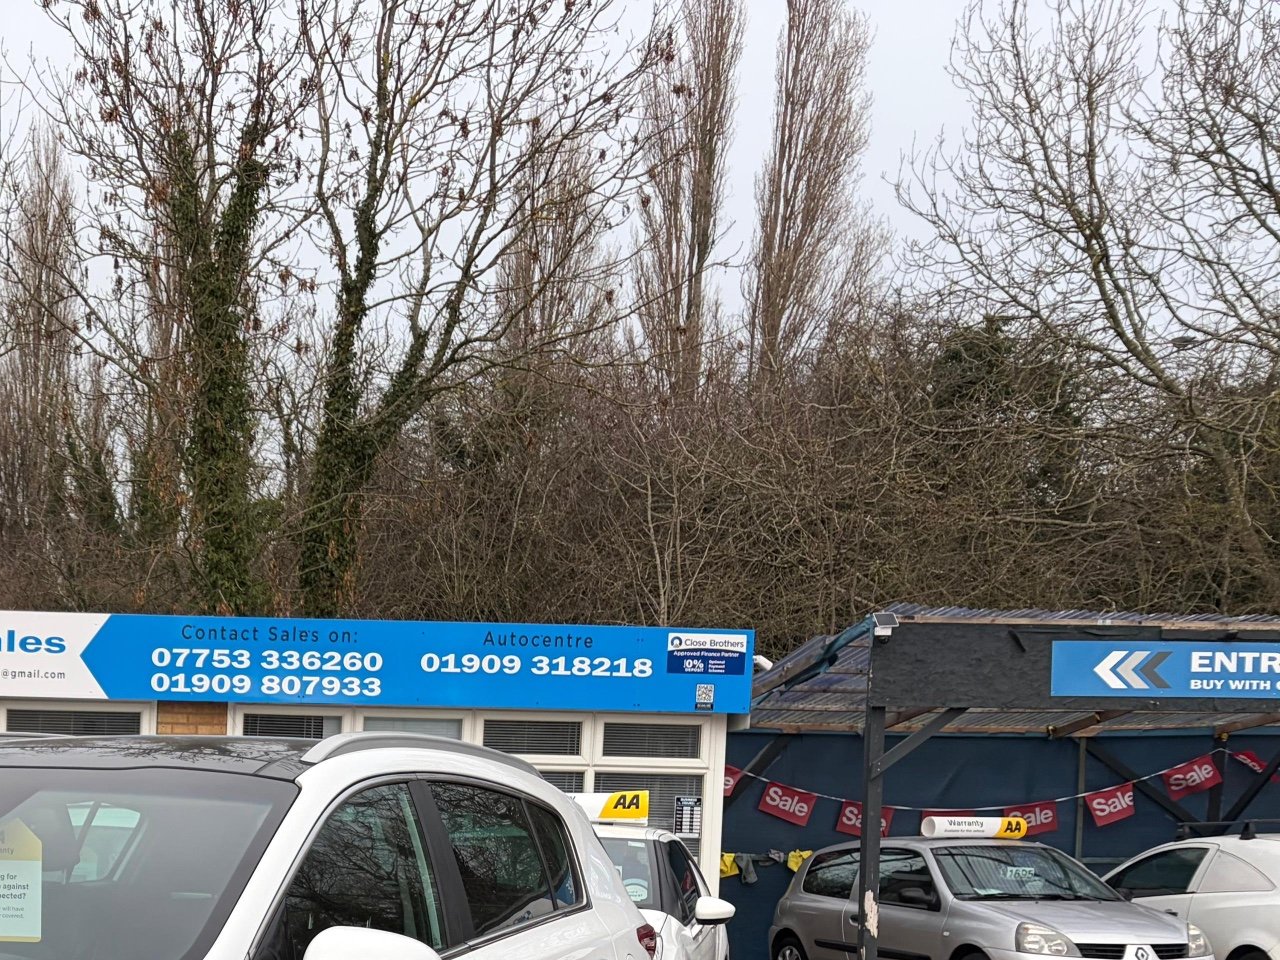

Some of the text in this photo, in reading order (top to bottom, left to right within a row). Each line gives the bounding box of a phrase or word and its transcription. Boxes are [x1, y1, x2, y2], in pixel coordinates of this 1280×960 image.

[181, 624, 358, 644] Contact Sales on:
[483, 631, 593, 649] Autocentre
[684, 638, 744, 648] Close Brothers
[151, 647, 383, 672] 07753 336260
[420, 653, 653, 678] 01909 318218
[1190, 651, 1280, 674] ENTR
[150, 672, 382, 697] 01909 807933
[1190, 679, 1224, 690] BUY
[1228, 680, 1271, 690] WITH
[1169, 763, 1213, 791] Sale
[613, 794, 640, 810] AA
[765, 786, 808, 817] Sale
[1092, 791, 1134, 816] Sale
[947, 819, 984, 828] Warranty
[1004, 820, 1022, 833] AA
